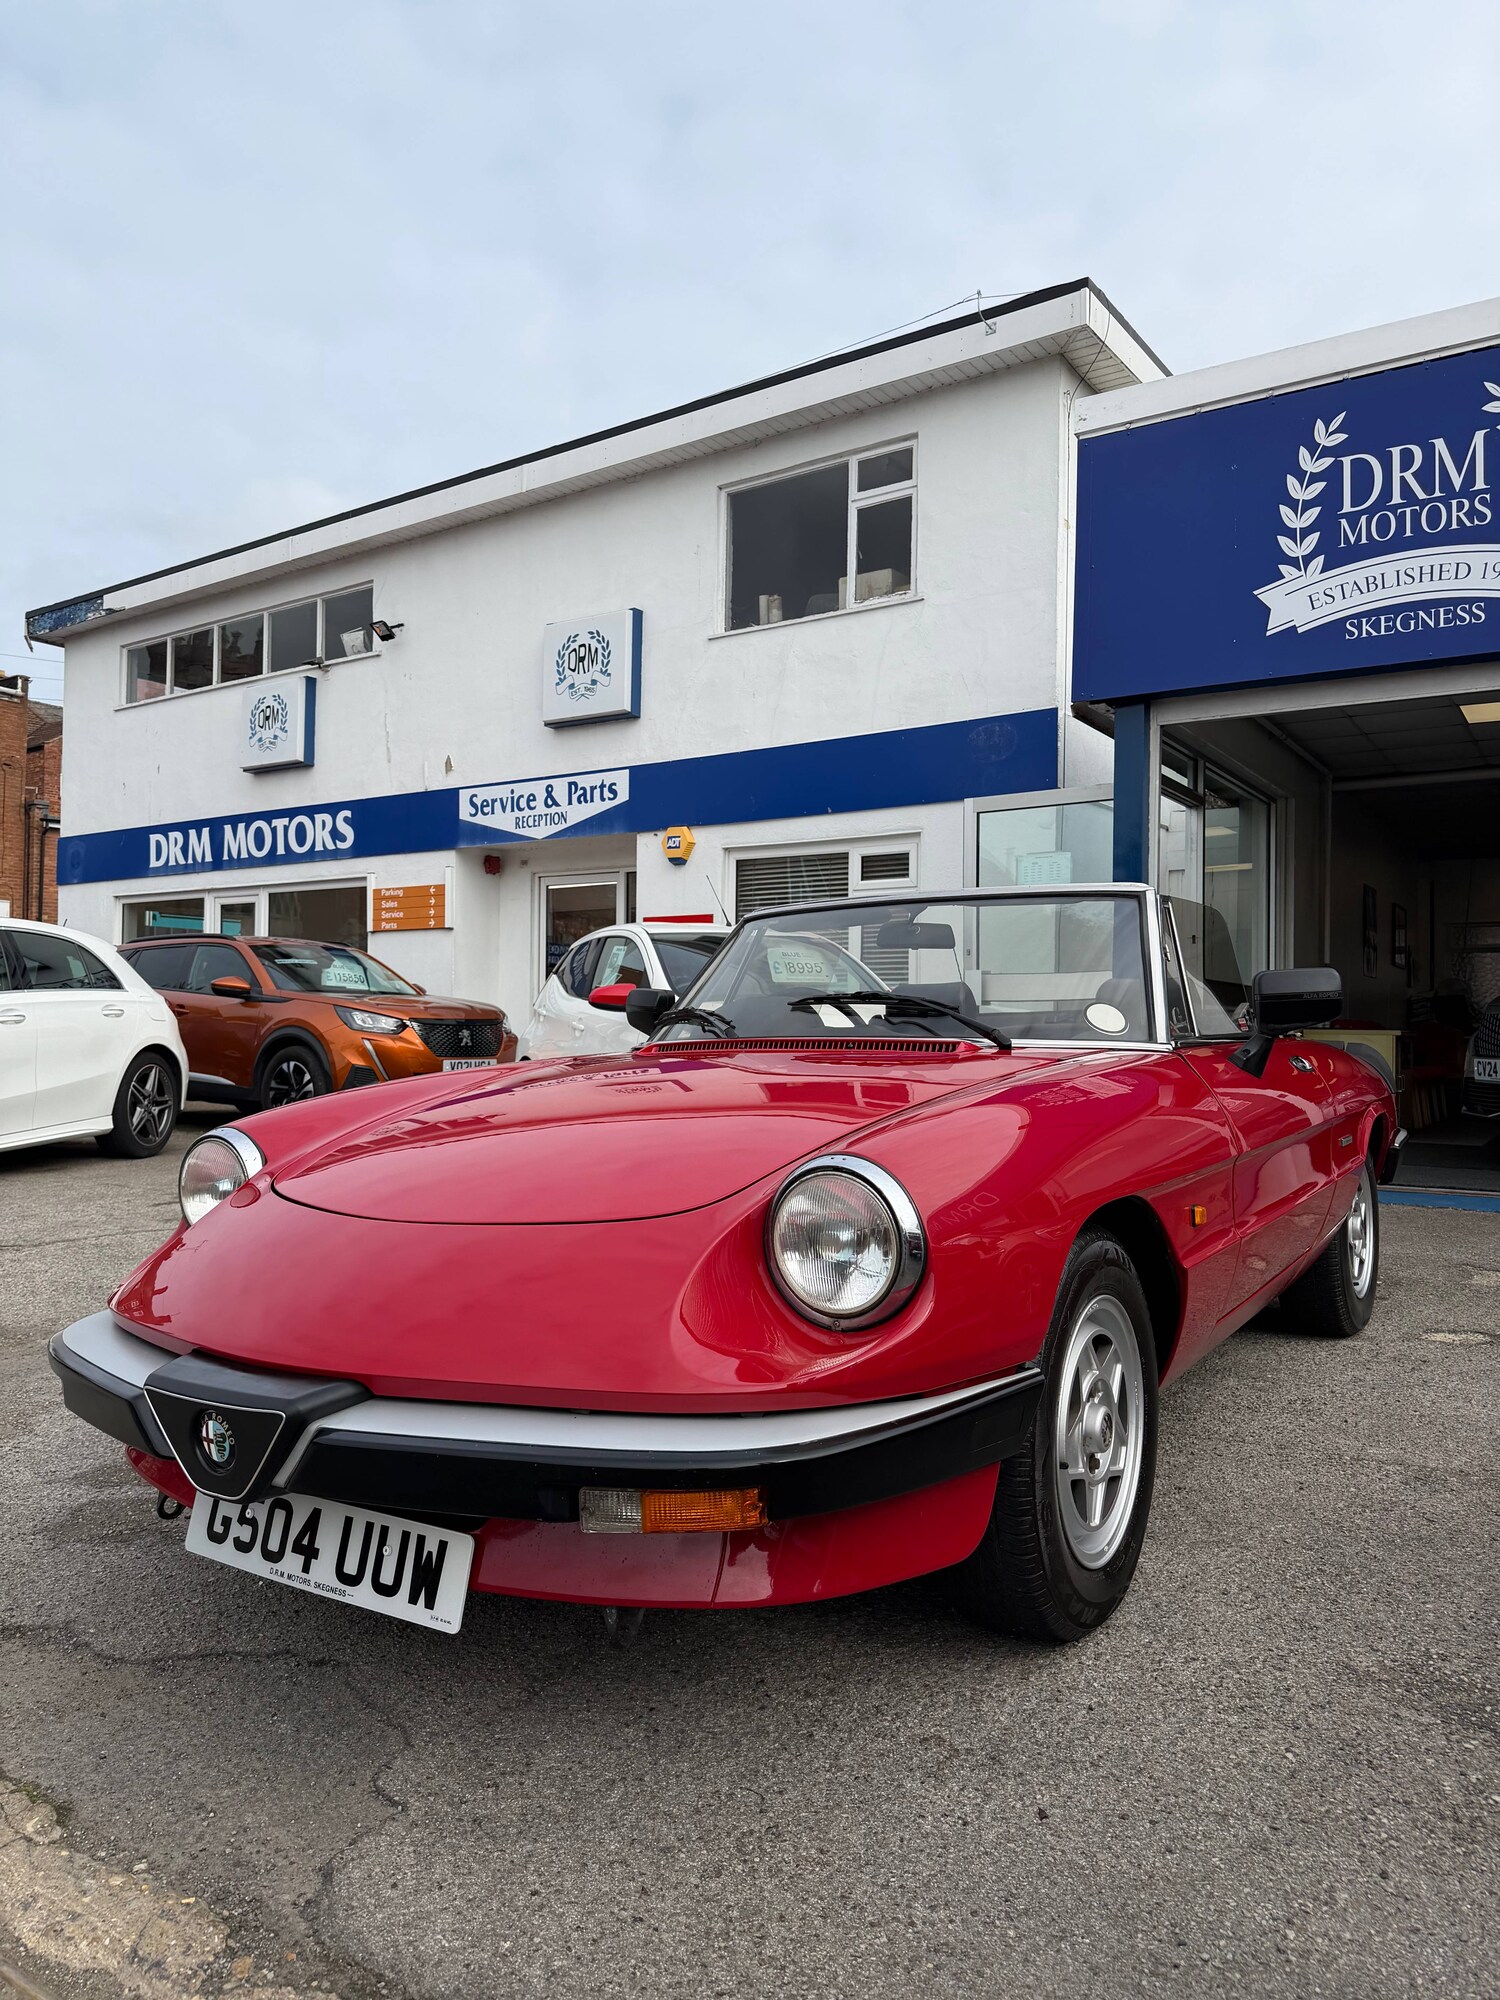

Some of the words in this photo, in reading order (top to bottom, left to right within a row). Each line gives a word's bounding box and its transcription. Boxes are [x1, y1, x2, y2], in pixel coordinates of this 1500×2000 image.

[1337, 428, 1490, 514] DRM
[1338, 493, 1492, 548] MOTORS
[1308, 561, 1472, 611] ESTABLISHED
[1345, 602, 1485, 640] SKEGNESS
[568, 643, 598, 674] DRM
[257, 705, 279, 731] DRM
[469, 789, 537, 817] Service
[543, 784, 561, 808] &
[567, 779, 618, 805] Parts
[514, 811, 568, 829] RECEPTION
[149, 827, 213, 868] DRM
[222, 810, 355, 861] MOTORS
[667, 837, 681, 849] ADT
[381, 889, 403, 897] Parking
[381, 900, 398, 908] Sales
[381, 910, 403, 919] Service
[381, 921, 397, 929] Parts
[1477, 1060, 1498, 1077] CV24
[211, 1412, 235, 1446] ROMEO
[206, 1497, 322, 1574] G504
[334, 1515, 449, 1611] UUW
[313, 1581, 346, 1597] SKEGNESS
